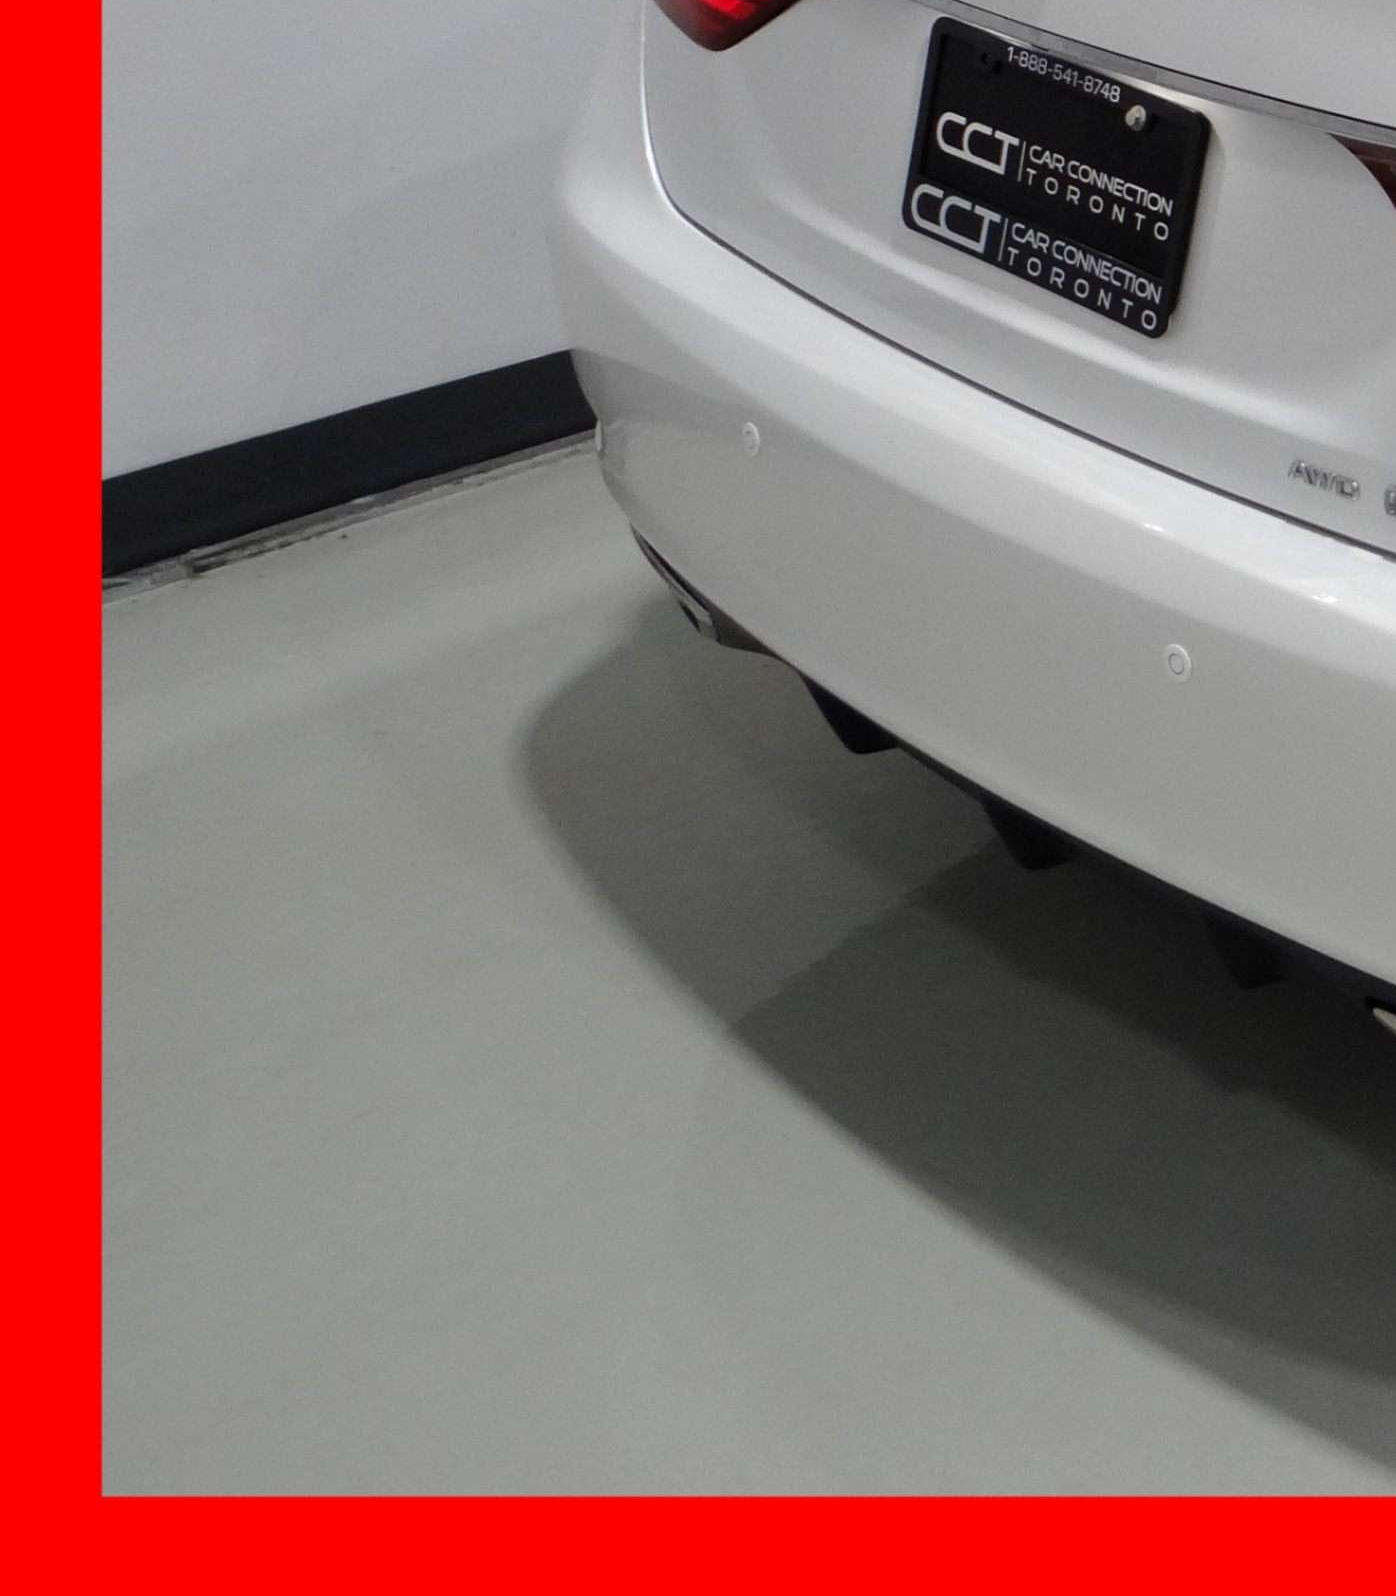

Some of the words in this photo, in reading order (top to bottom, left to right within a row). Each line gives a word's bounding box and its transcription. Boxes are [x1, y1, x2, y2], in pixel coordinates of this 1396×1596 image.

[1007, 46, 1121, 103] 1-888-541-8748
[936, 111, 1021, 176] CCT
[1028, 144, 1066, 173] CAR
[1066, 160, 1174, 217] CONNECTION
[911, 183, 1002, 254] CCT
[1010, 221, 1051, 254] CAR
[1051, 238, 1163, 305] CONNECTION
[1025, 167, 1170, 242] TORONTO
[1006, 246, 1157, 331] TORONTO
[1287, 459, 1362, 500] AWD
